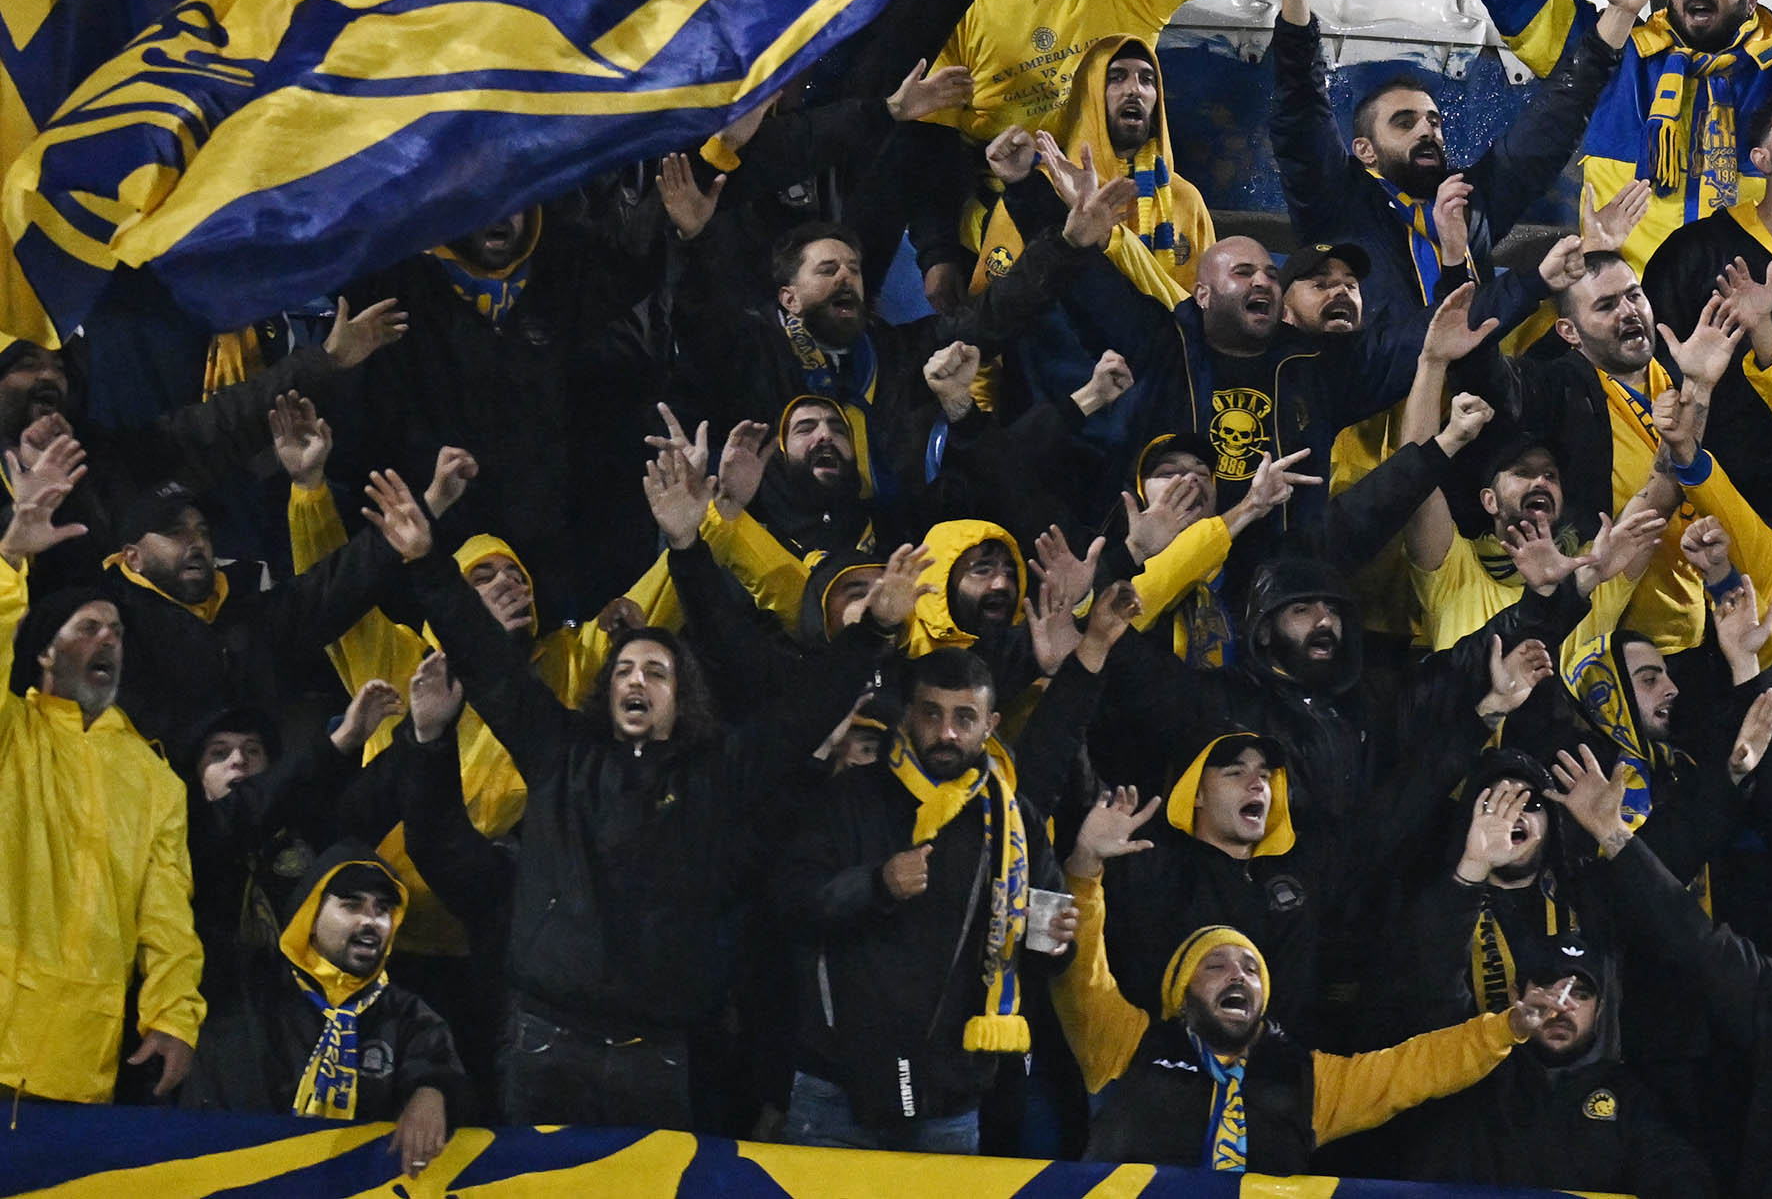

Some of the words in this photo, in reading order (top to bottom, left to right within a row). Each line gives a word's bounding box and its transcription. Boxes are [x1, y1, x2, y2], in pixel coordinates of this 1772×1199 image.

[1020, 43, 1082, 73] IMPERIAL
[1040, 66, 1058, 79] VS
[1216, 454, 1247, 476] 989
[897, 1057, 916, 1117] CATERPILLAR
